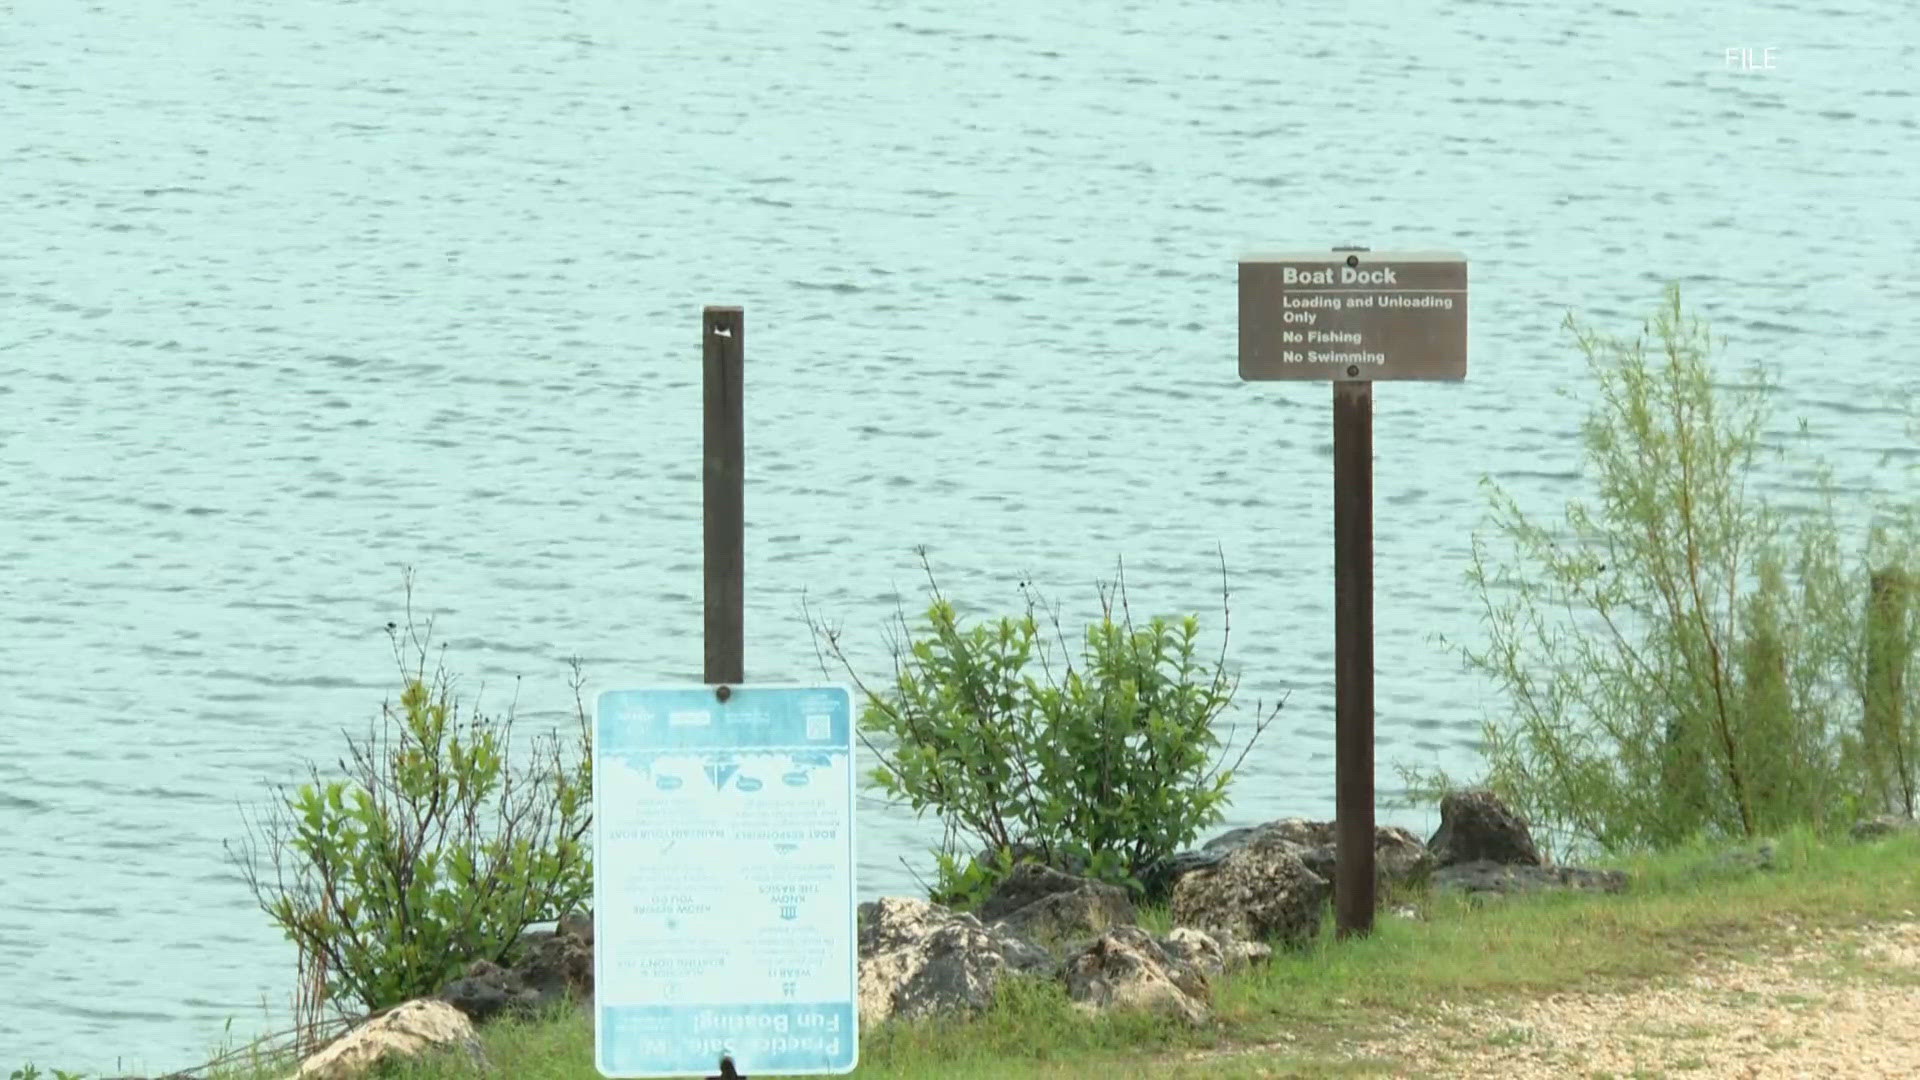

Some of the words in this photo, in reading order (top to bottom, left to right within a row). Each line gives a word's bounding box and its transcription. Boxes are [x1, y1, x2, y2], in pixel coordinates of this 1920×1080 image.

[1283, 268, 1333, 284] Boat
[1341, 267, 1396, 284] Dock
[1283, 296, 1341, 310] Loading
[1346, 297, 1373, 308] and
[1378, 296, 1452, 310] Unloading
[1283, 312, 1316, 324] Only
[1283, 332, 1302, 342] No
[1308, 331, 1361, 345] Fishing
[1283, 351, 1302, 362] No
[1308, 351, 1385, 364] Swimming
[808, 830, 836, 839] BOAT
[798, 884, 818, 893] THE
[770, 895, 806, 904] KNOW
[693, 1010, 788, 1034] Boating!
[796, 1013, 840, 1033] Fun
